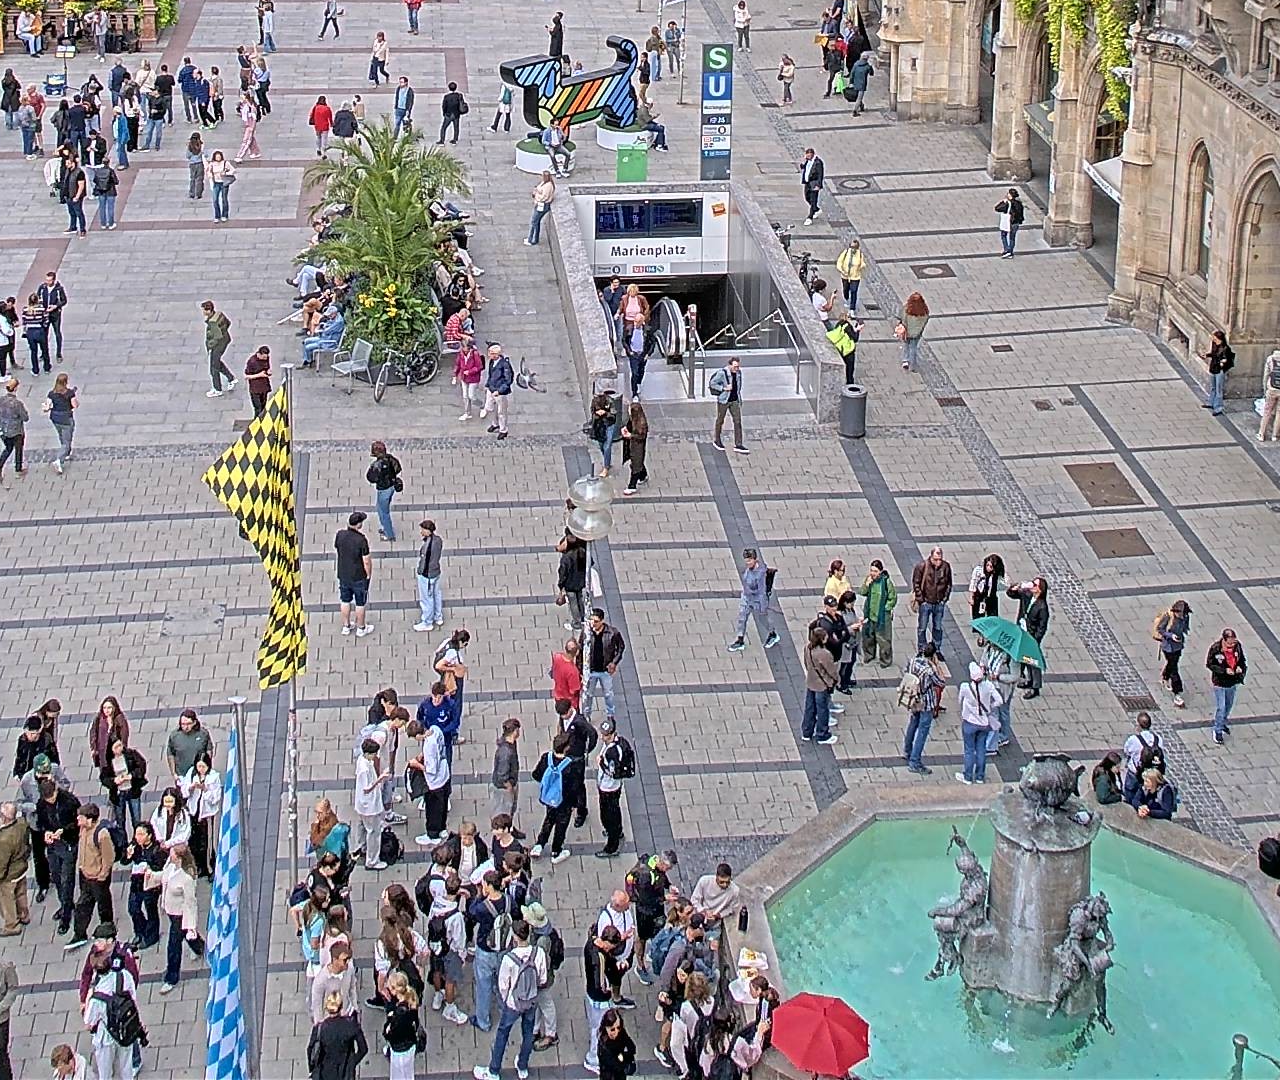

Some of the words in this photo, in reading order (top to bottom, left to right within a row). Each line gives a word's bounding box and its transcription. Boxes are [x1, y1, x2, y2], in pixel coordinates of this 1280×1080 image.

[709, 47, 728, 69] S
[708, 76, 726, 97] U
[610, 245, 686, 258] Marienplatz
